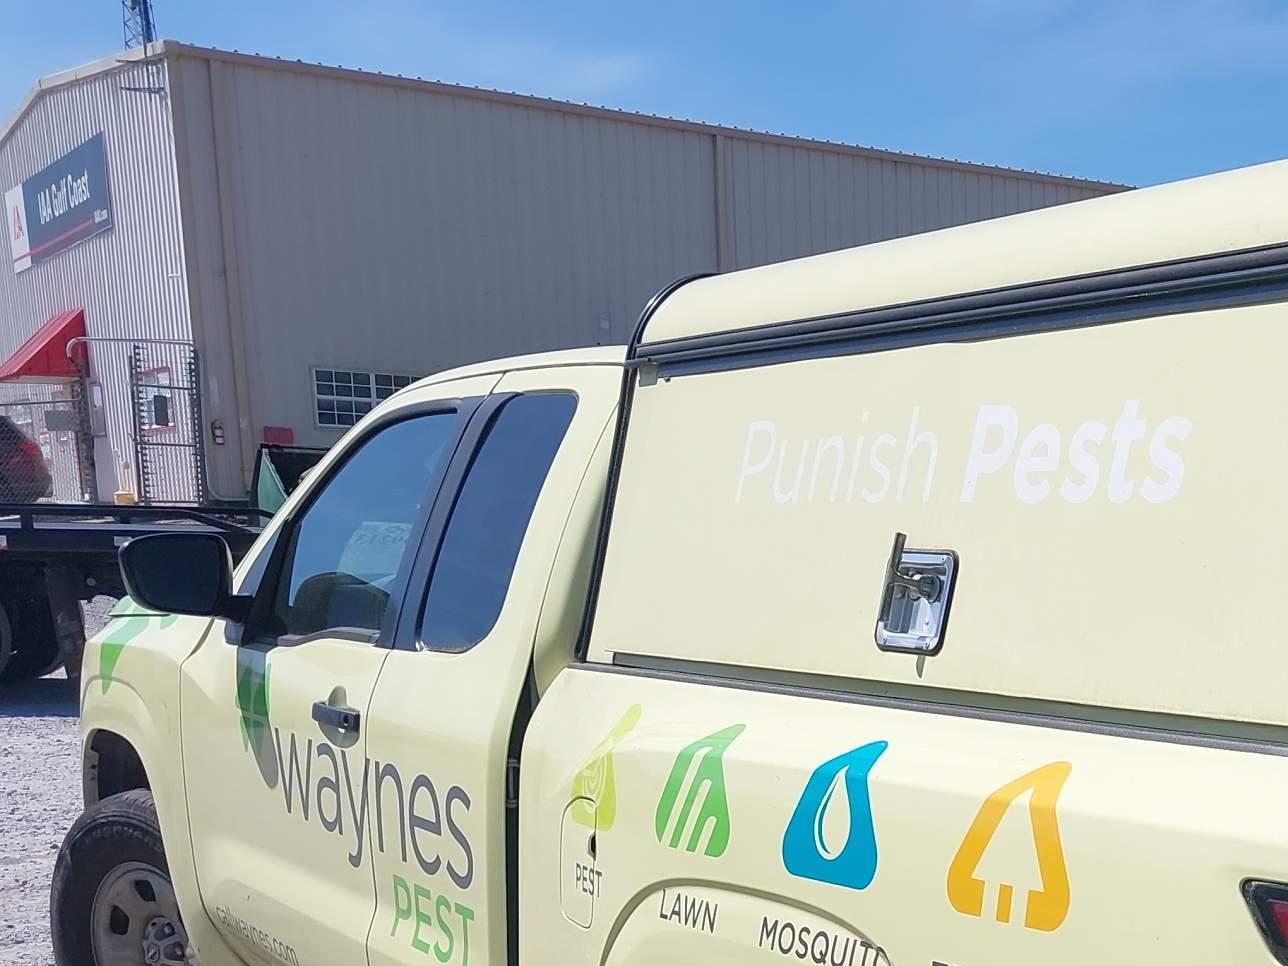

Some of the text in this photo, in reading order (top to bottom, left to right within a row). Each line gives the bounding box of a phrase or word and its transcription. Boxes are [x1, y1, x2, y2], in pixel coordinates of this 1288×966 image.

[38, 188, 53, 224] IAA
[51, 177, 68, 217] Gulf
[67, 168, 90, 208] Coast
[735, 399, 1193, 504] Punish Pests
[275, 727, 474, 890] waynes
[575, 862, 603, 898] PEST
[659, 888, 719, 934] LAWN
